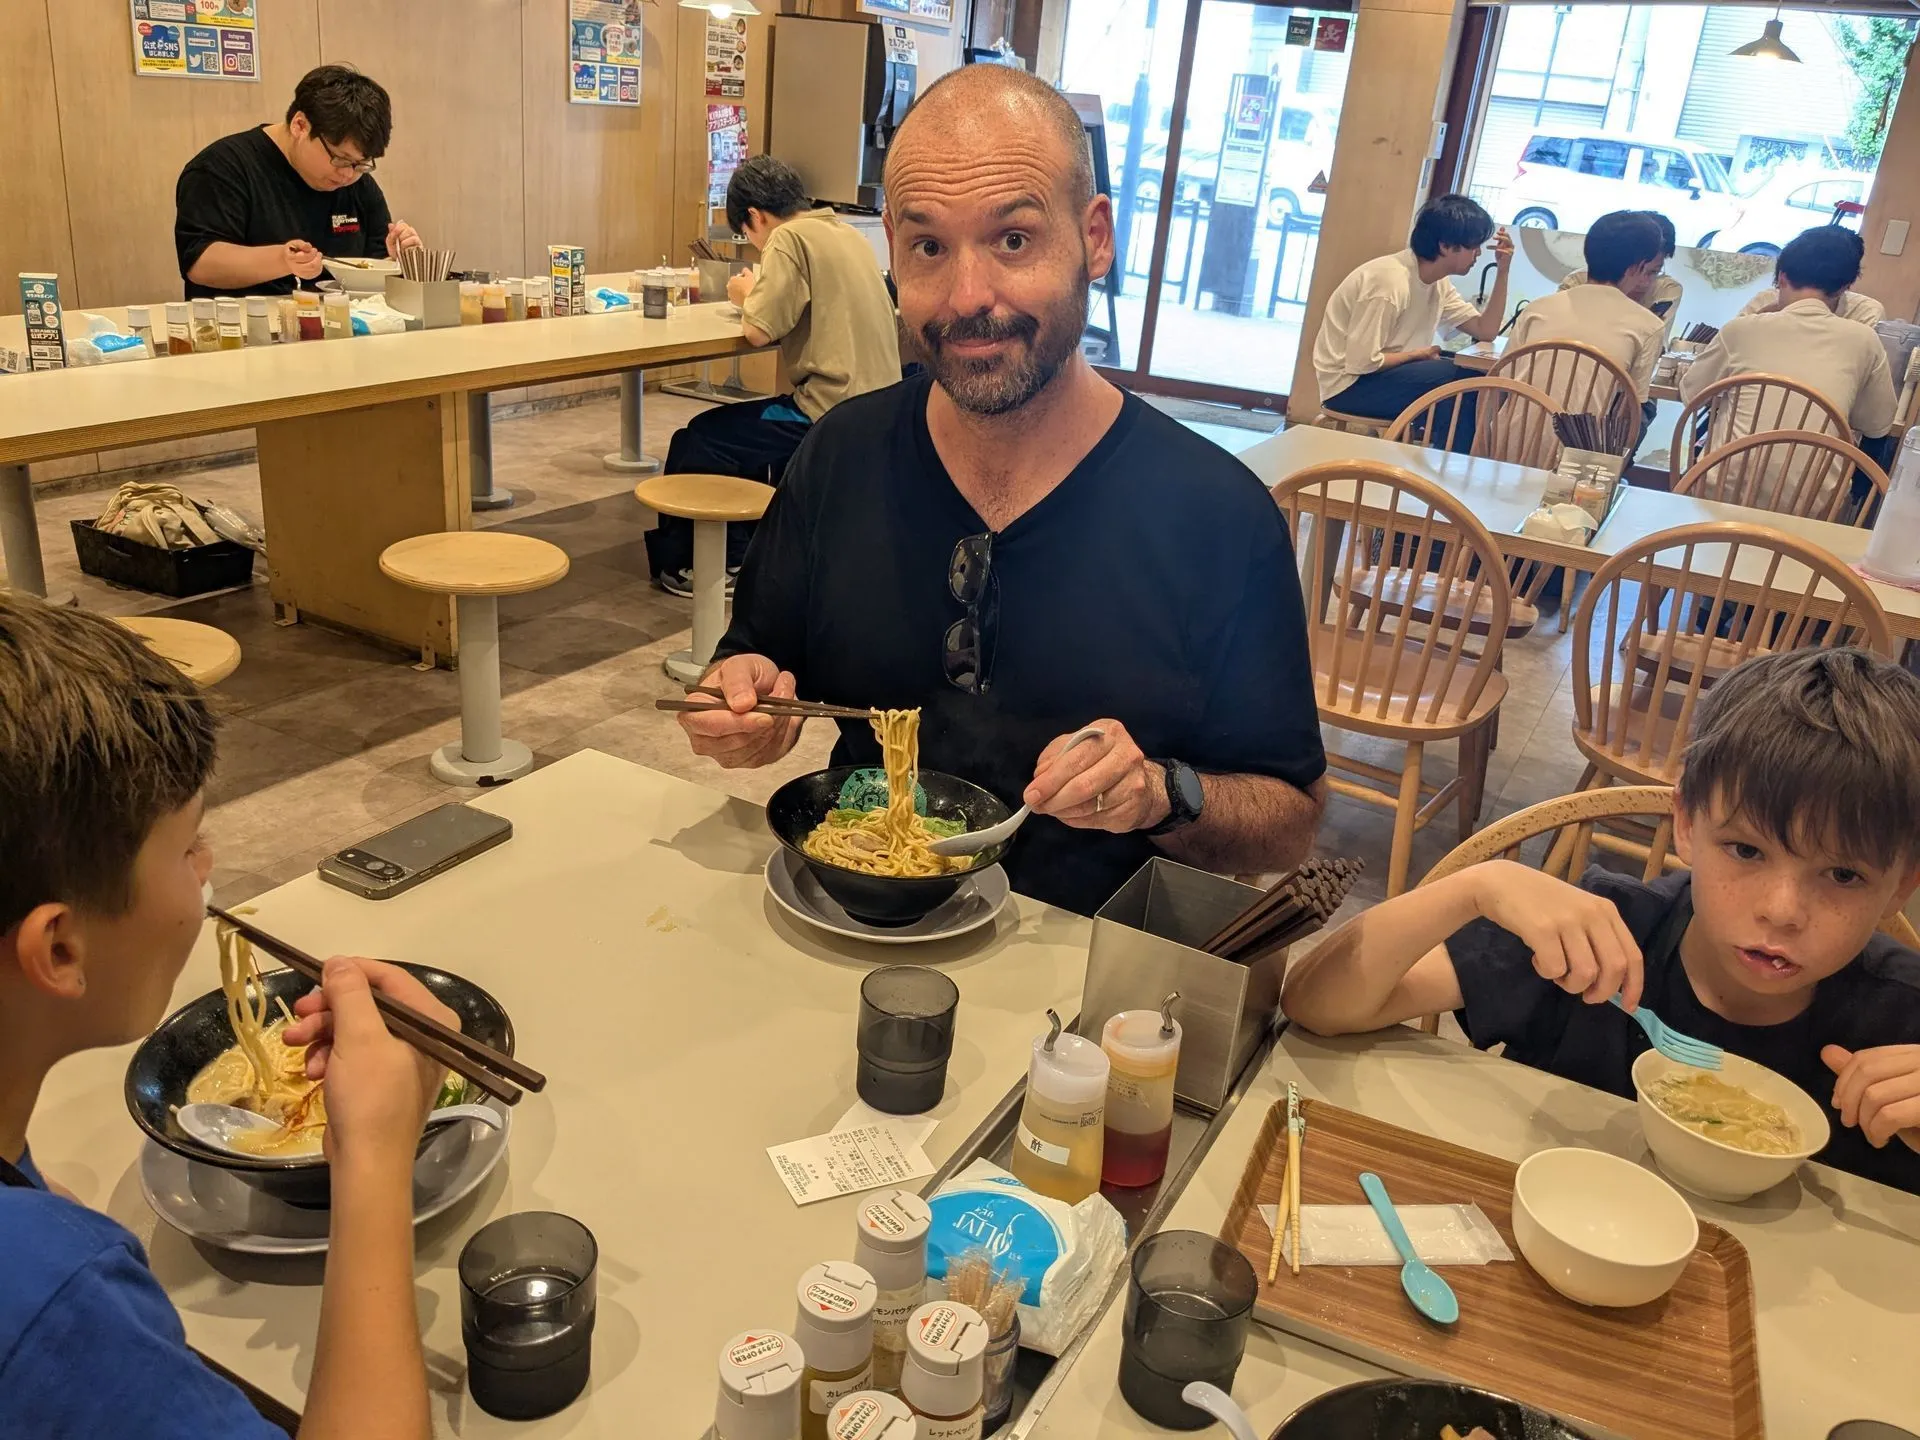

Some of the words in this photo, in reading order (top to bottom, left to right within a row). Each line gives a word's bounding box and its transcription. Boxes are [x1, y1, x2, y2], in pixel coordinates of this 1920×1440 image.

[193, 30, 210, 38] Twitter
[164, 41, 179, 51] SNS
[1030, 1137, 1043, 1153] 酢
[812, 1285, 855, 1307] ワンタッチOPEN
